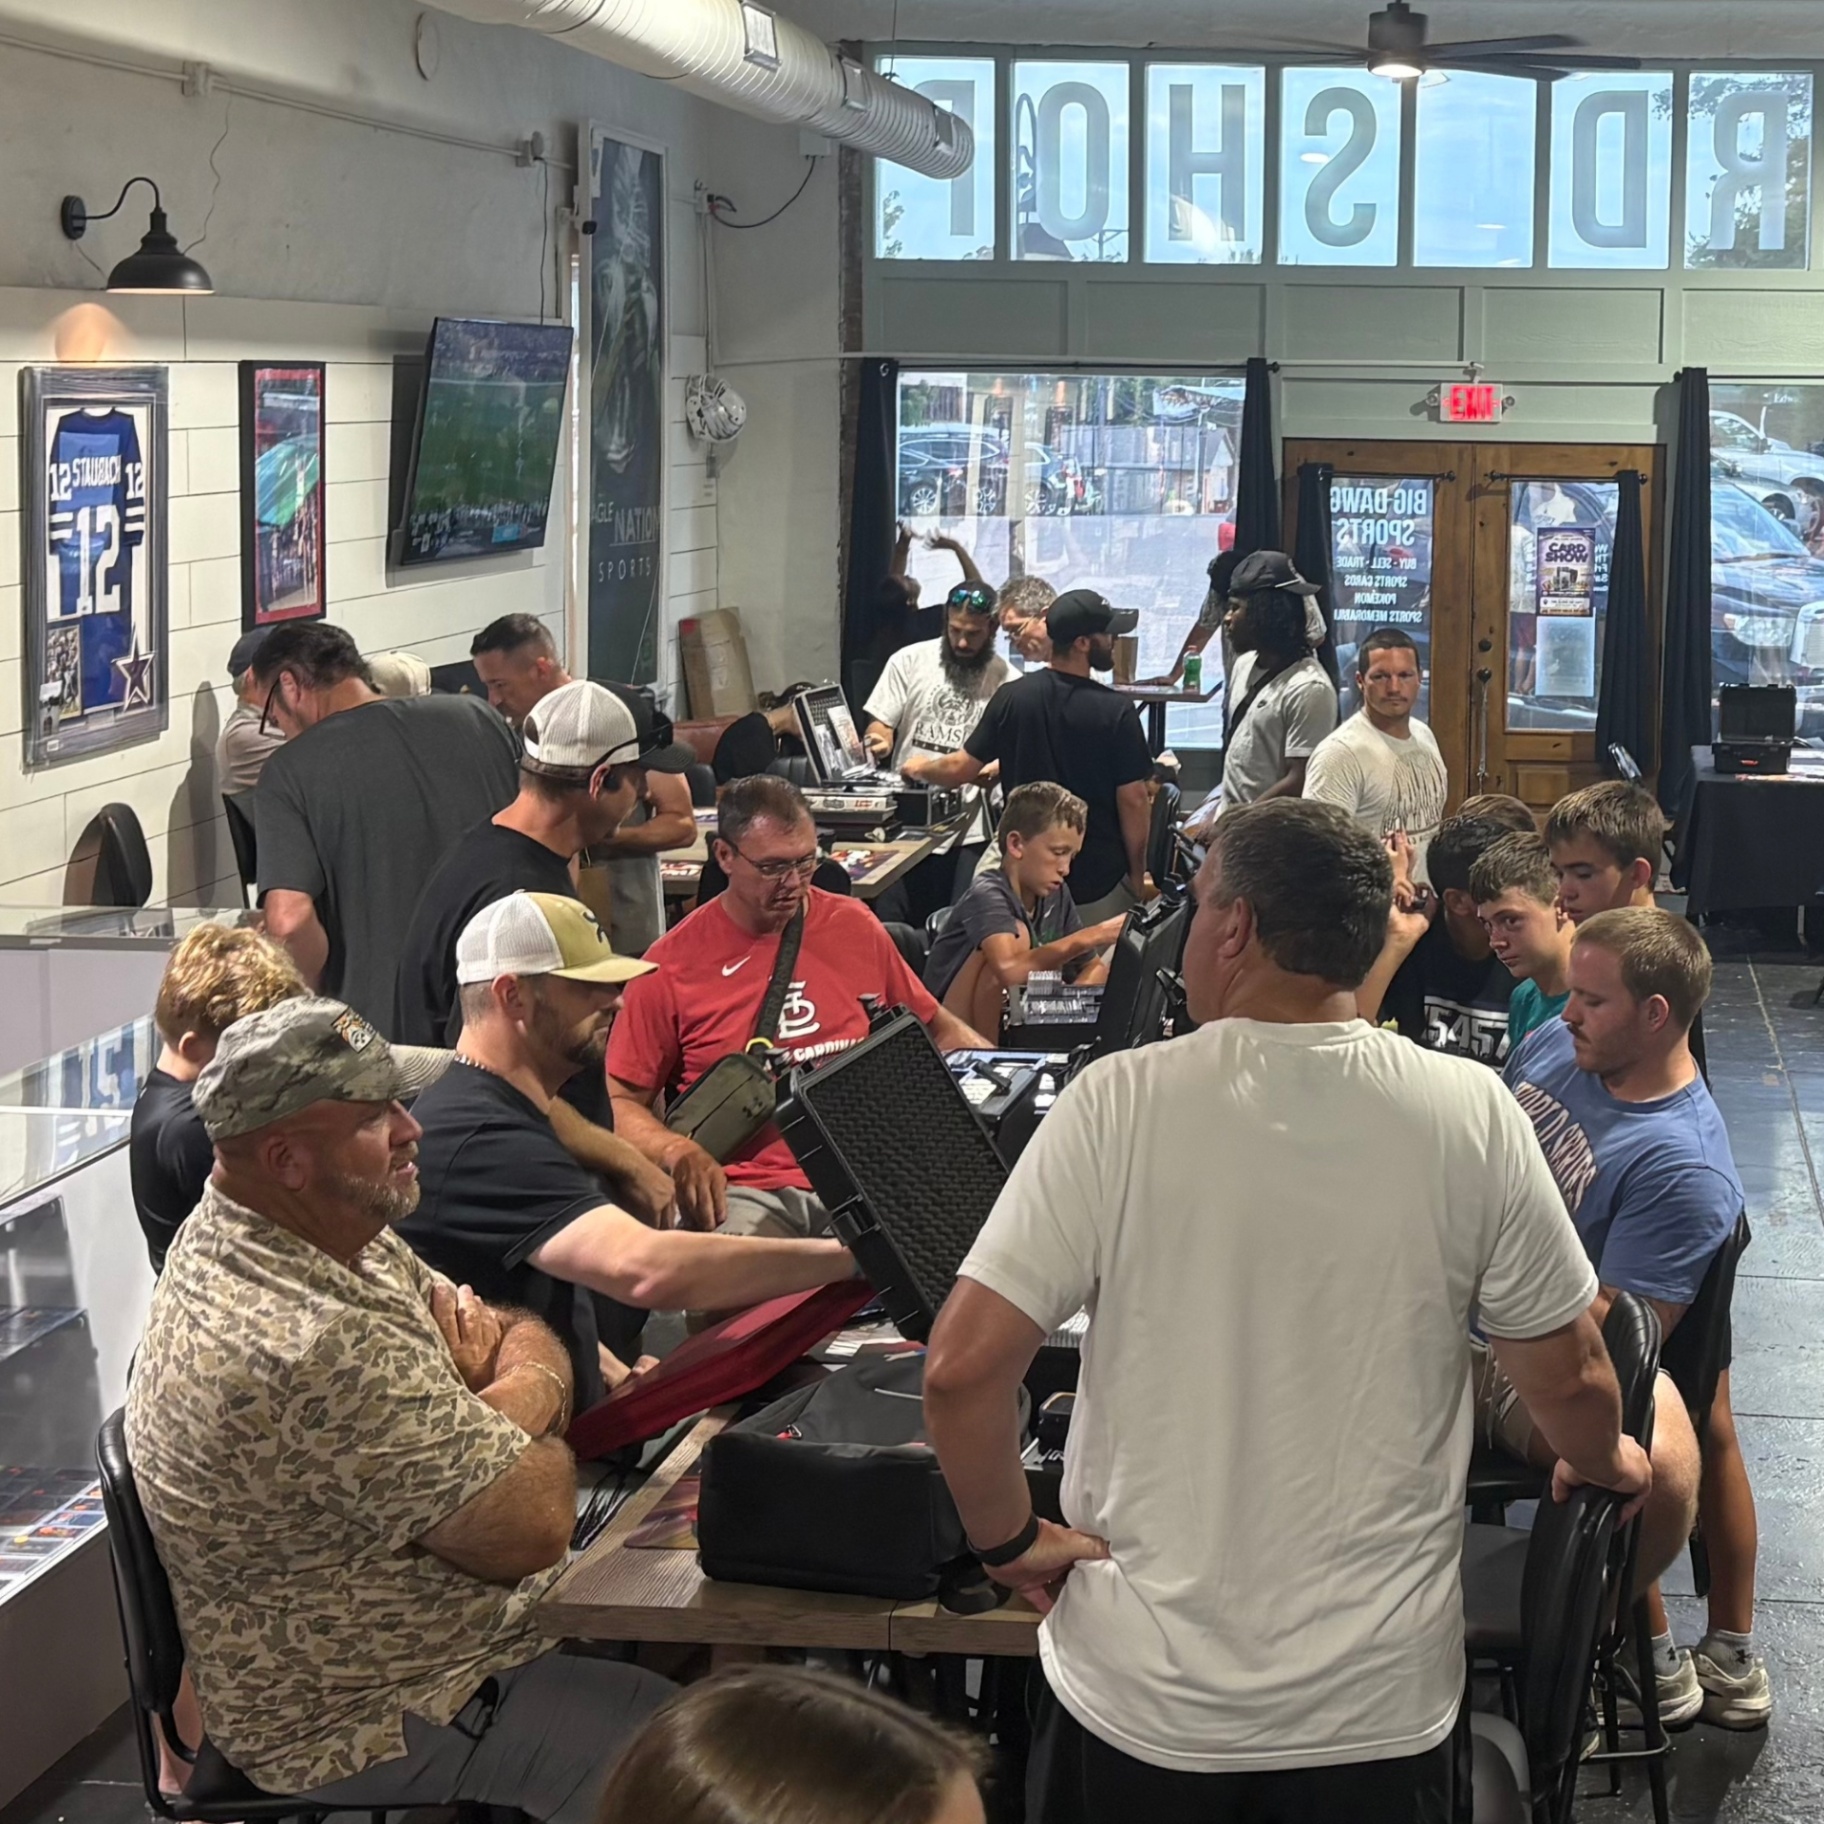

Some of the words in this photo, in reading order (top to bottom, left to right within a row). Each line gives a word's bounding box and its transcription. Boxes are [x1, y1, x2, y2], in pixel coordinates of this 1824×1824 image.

[1450, 386, 1493, 420] EXIT
[50, 463, 72, 501] 12
[125, 462, 144, 500] 12
[76, 504, 120, 614] 12
[1545, 551, 1588, 562] SHOW
[1548, 542, 1586, 553] CARD
[598, 556, 652, 583] SPORTS
[913, 721, 967, 744] RAMS
